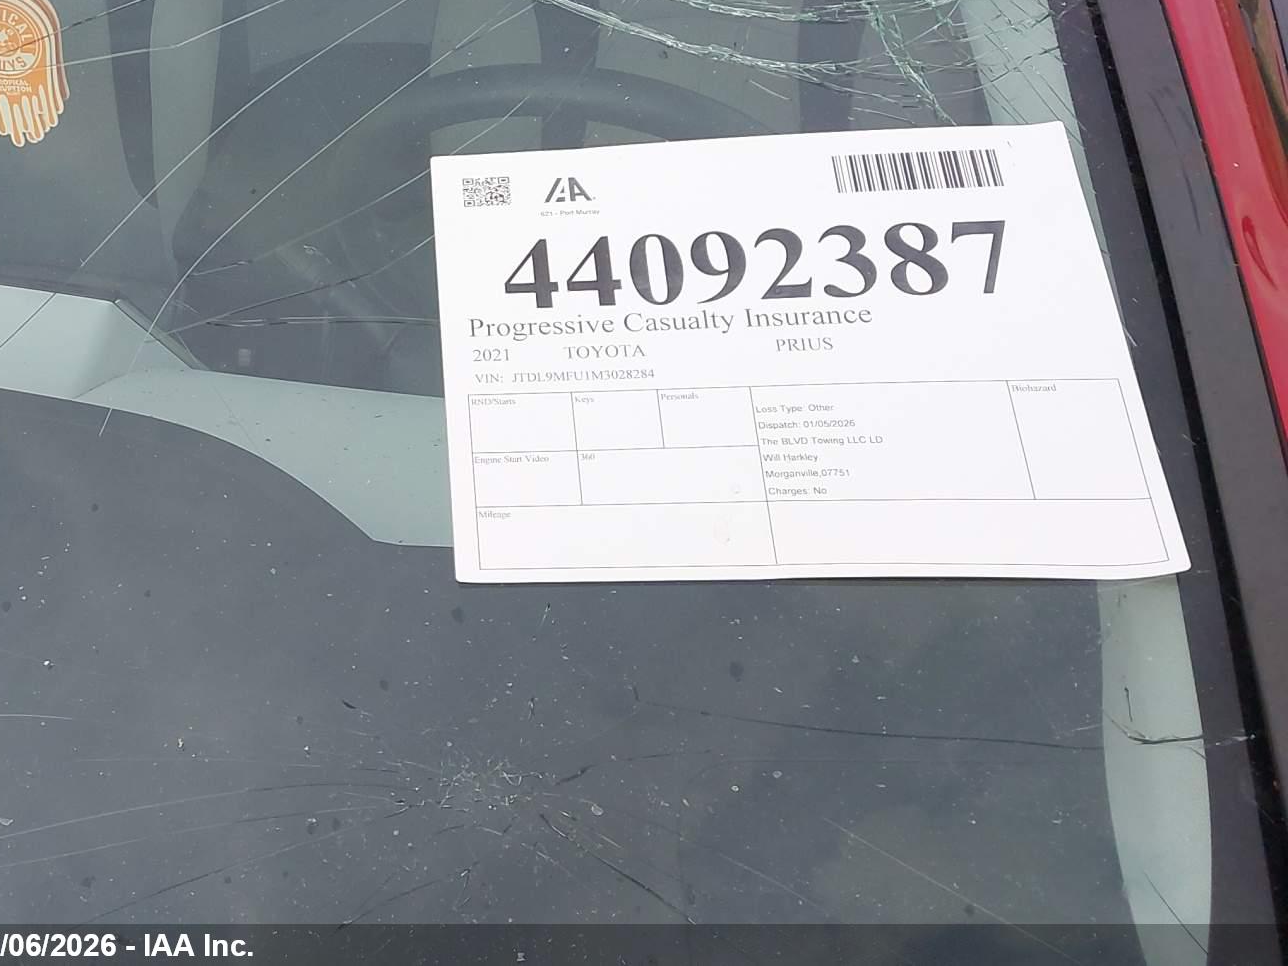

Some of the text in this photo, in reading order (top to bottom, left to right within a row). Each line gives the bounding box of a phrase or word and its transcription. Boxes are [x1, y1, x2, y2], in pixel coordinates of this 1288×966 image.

[504, 220, 1006, 309] 44092387
[469, 306, 873, 341] Progressive Casualty Insurance
[472, 336, 834, 362] 2021 TOYOTA PRIUS
[475, 369, 655, 384] VIN: JTDL9MFU1M3028284
[1011, 383, 1057, 393] Biohazard
[574, 395, 595, 404] Keys
[660, 392, 699, 401] Personals
[755, 405, 778, 413] Loss
[808, 403, 835, 412] Other
[758, 421, 800, 430] Dispatch:
[760, 435, 884, 446] The BLVD Towing LLC LD
[474, 454, 550, 465] Engine Start Video
[581, 453, 596, 461] 360
[763, 454, 781, 462] Will
[768, 486, 828, 496] Charges: No
[478, 510, 511, 520] Mileage
